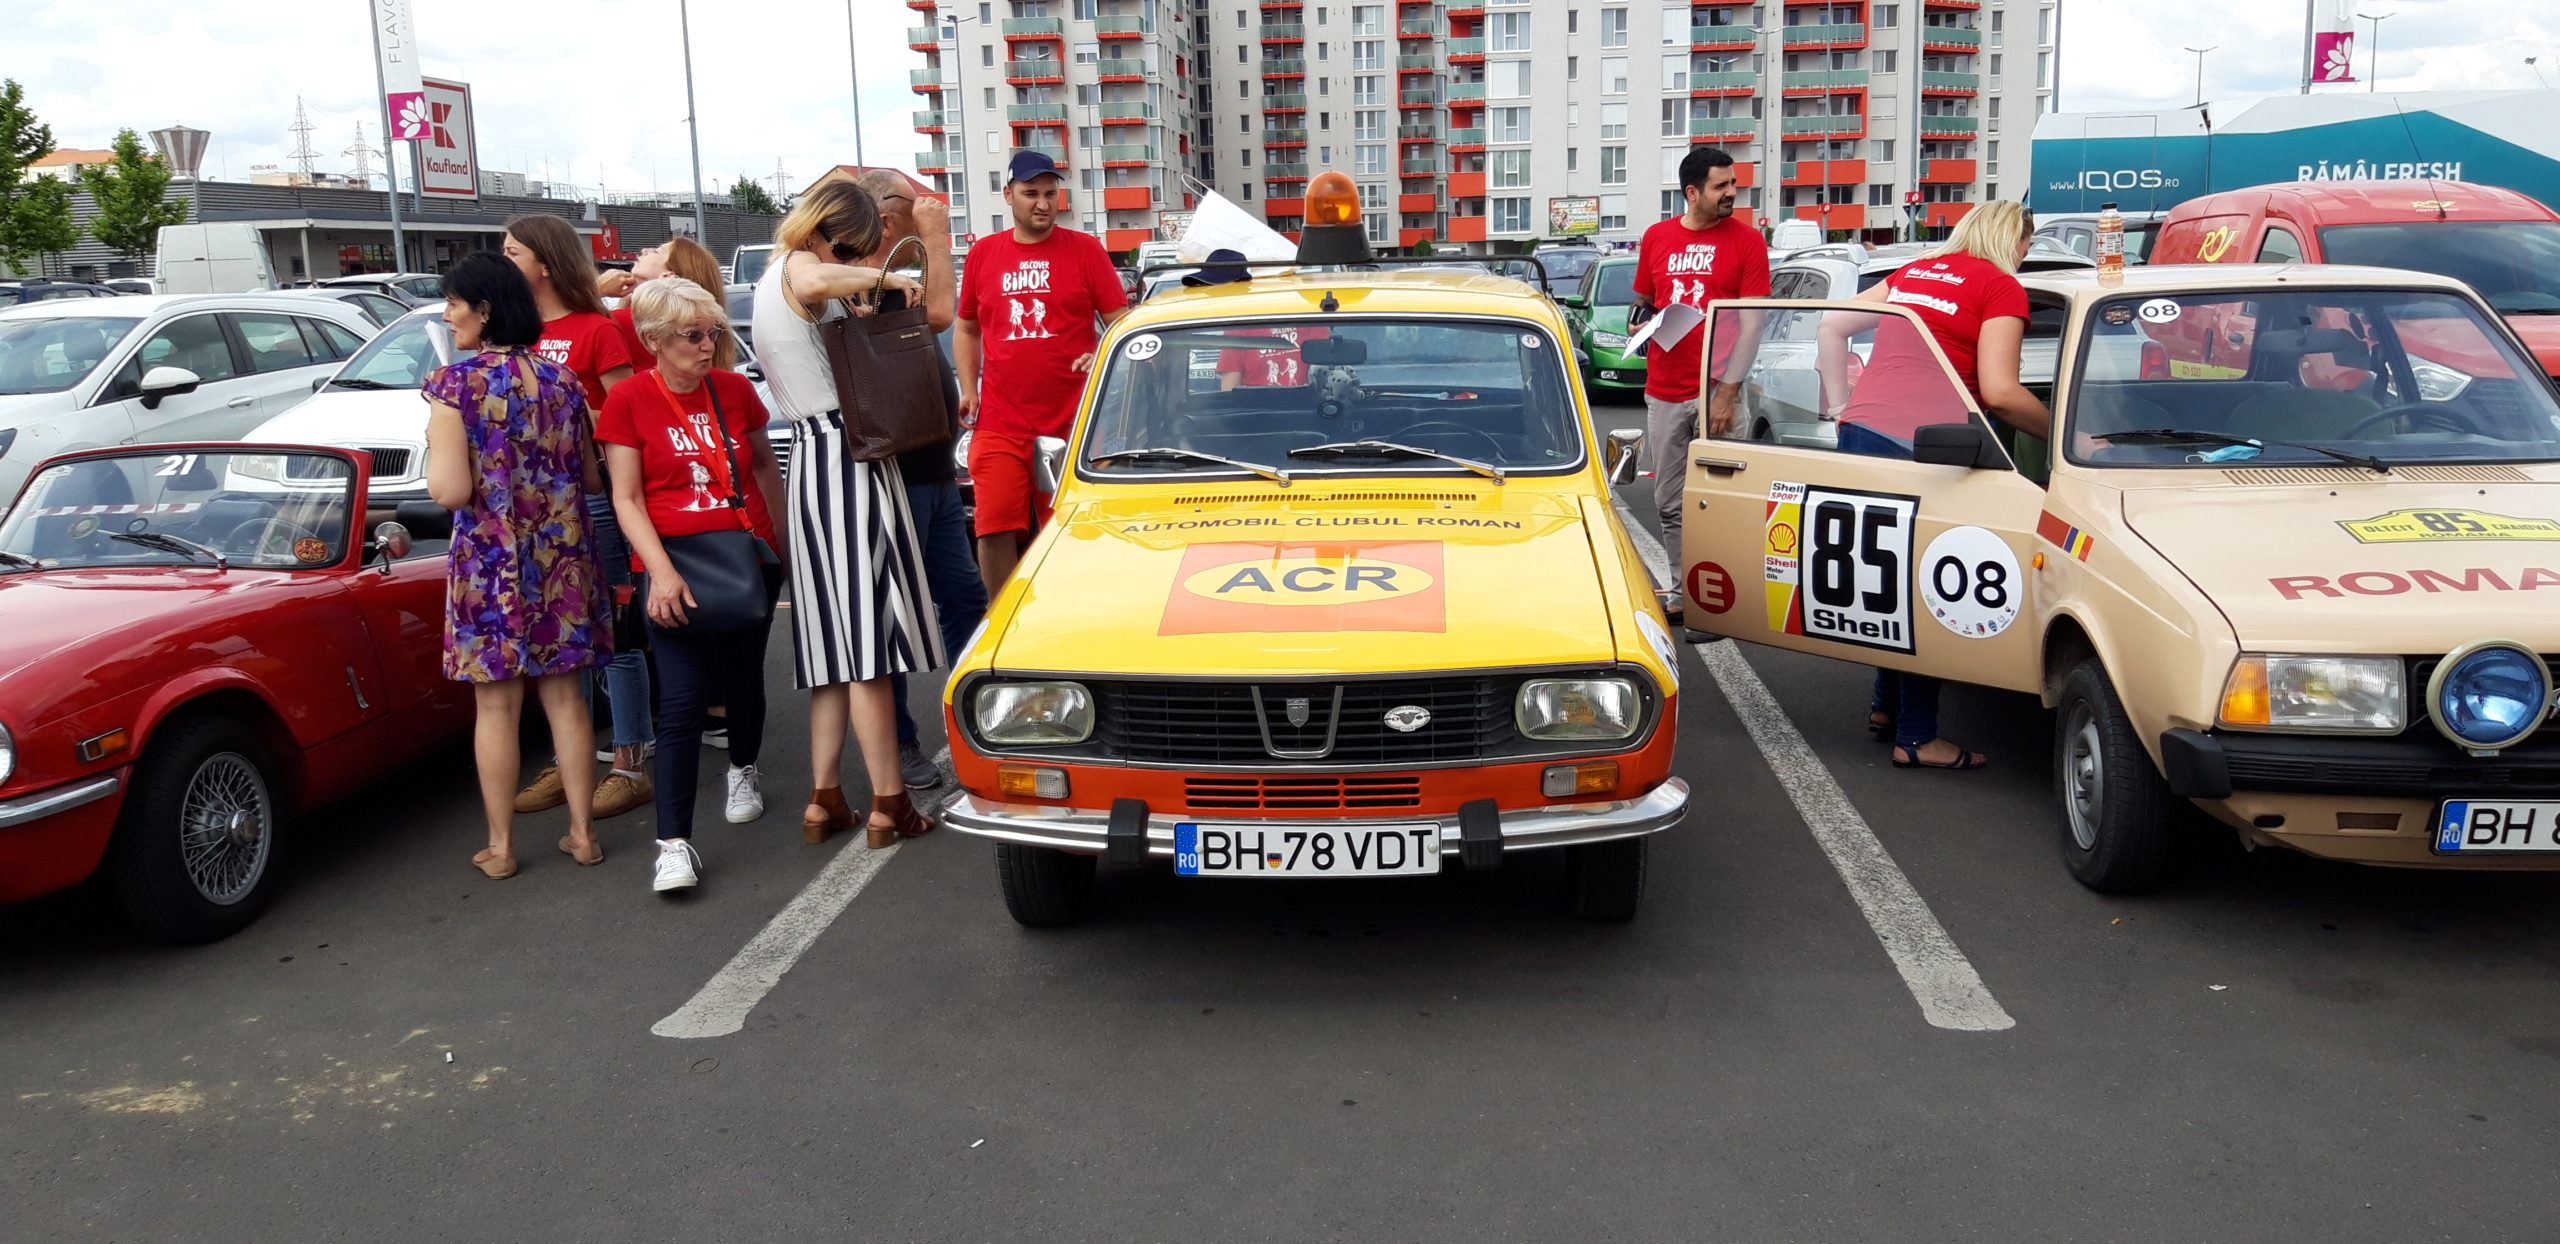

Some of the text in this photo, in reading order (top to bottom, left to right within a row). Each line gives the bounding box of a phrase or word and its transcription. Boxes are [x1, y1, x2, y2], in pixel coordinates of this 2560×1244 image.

[426, 157, 468, 175] Kaufland
[2384, 162, 2462, 183] FRESH
[1685, 243, 1716, 254] DISCOVER
[1019, 260, 1050, 270] DISCOVER
[2142, 304, 2178, 318] 08
[540, 339, 572, 351] DISCOVER
[1128, 340, 1159, 355] 09
[154, 454, 197, 477] 21
[1772, 482, 1804, 494] Shell
[1770, 492, 1799, 502] SPORT
[1121, 517, 1522, 534] AUTOMOBIL CLUBUL ROMAN
[2363, 512, 2555, 533] OLTCIT 85 CRAIOVA
[1766, 556, 1797, 569] Shell
[1811, 500, 1899, 615] 85
[1766, 566, 1785, 575] Motor
[1766, 573, 1779, 581] Oils
[1215, 566, 1399, 594] ACR
[1698, 569, 1725, 608] E
[1932, 555, 2007, 609] 08
[1812, 608, 1901, 642] Shell
[2466, 808, 2537, 845] BH
[1202, 829, 1433, 871] BH 78 VDT
[1178, 856, 1198, 869] RO
